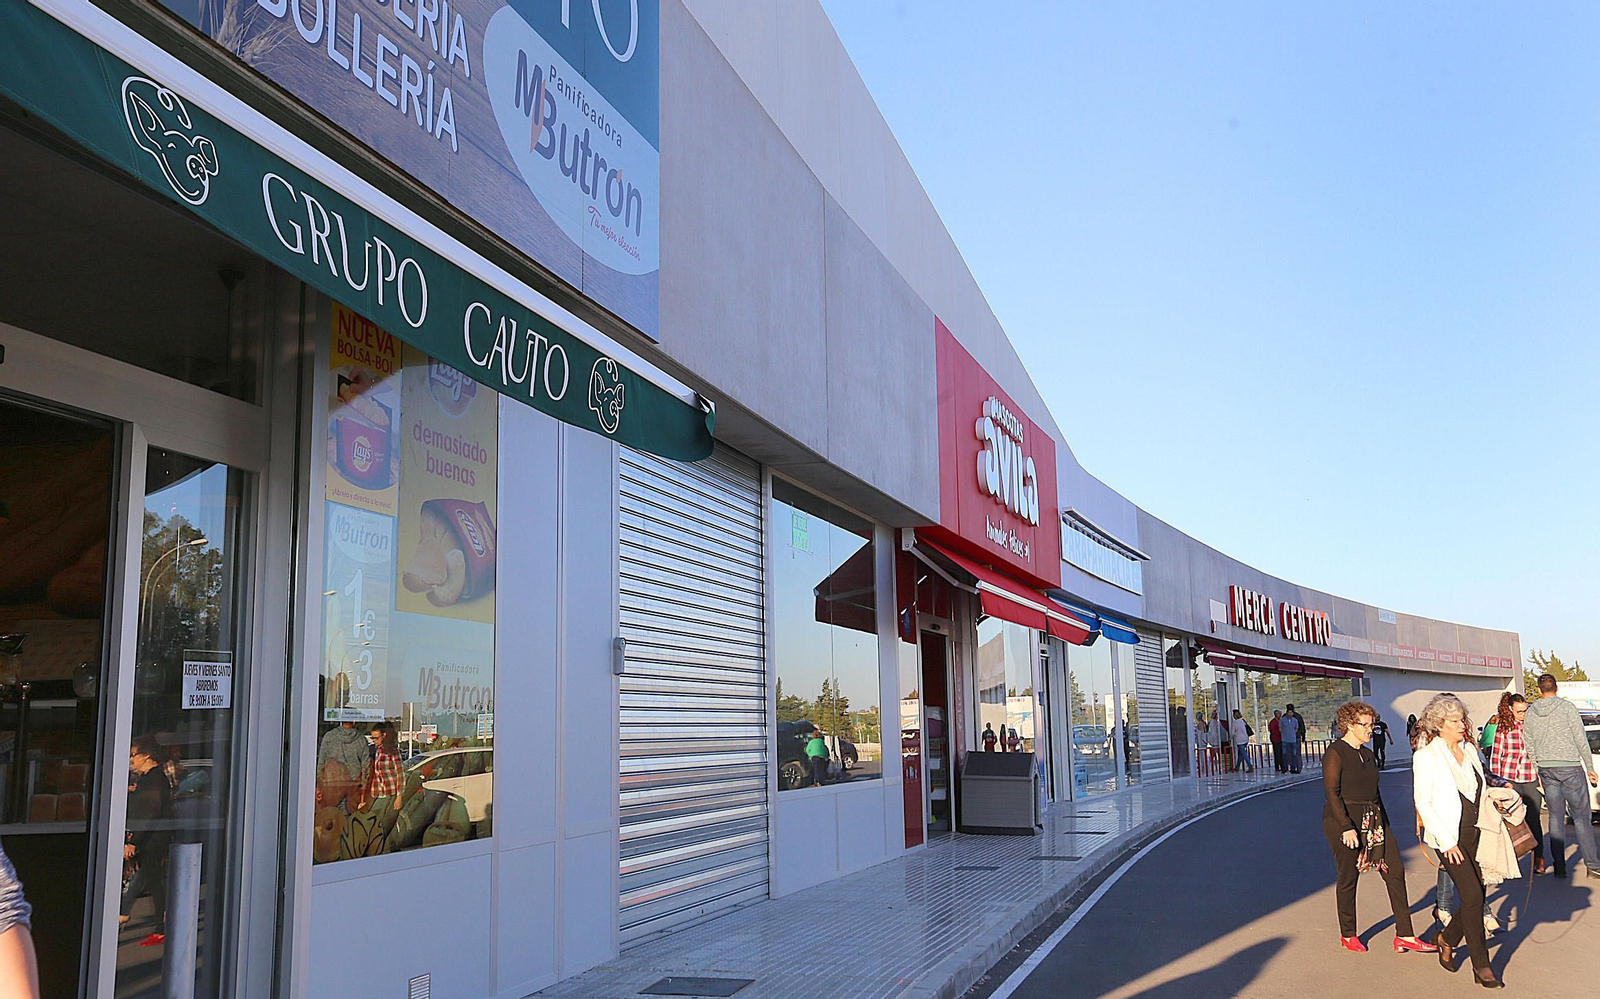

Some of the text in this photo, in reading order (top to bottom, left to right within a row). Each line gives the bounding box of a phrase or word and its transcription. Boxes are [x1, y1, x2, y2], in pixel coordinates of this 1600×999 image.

[256, 0, 459, 152] OLLERÍA
[549, 64, 623, 149] Panificadora
[262, 172, 570, 402] GRUPO CAUTO
[337, 309, 396, 358] NUEVA
[412, 420, 488, 465] demasiado
[426, 450, 476, 487] buenas
[1230, 584, 1332, 647] MERCA CENTRO
[436, 661, 480, 675] Panificadora
[350, 692, 379, 705] barras
